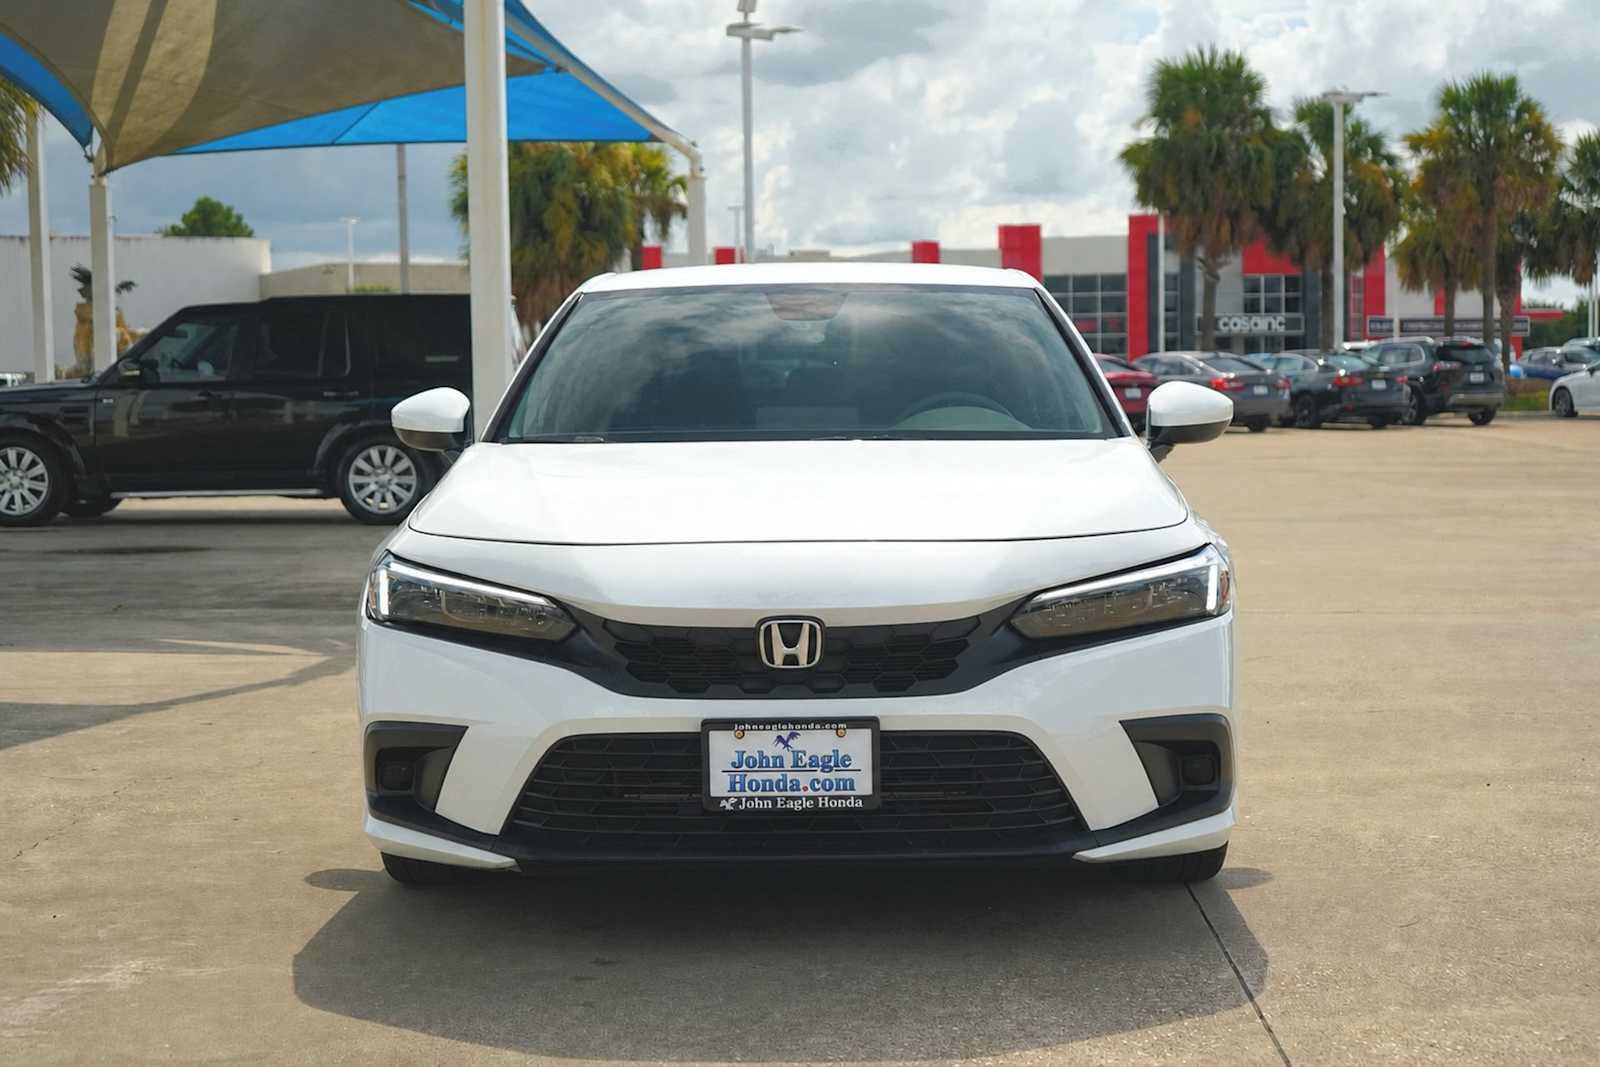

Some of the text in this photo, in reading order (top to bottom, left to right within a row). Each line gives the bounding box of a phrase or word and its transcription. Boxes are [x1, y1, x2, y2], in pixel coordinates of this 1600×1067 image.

[734, 723, 847, 731] johneaglehonda.com
[731, 749, 852, 773] John Eagle
[727, 774, 856, 793] Honda.com
[738, 796, 863, 811] John Eagle Honda
